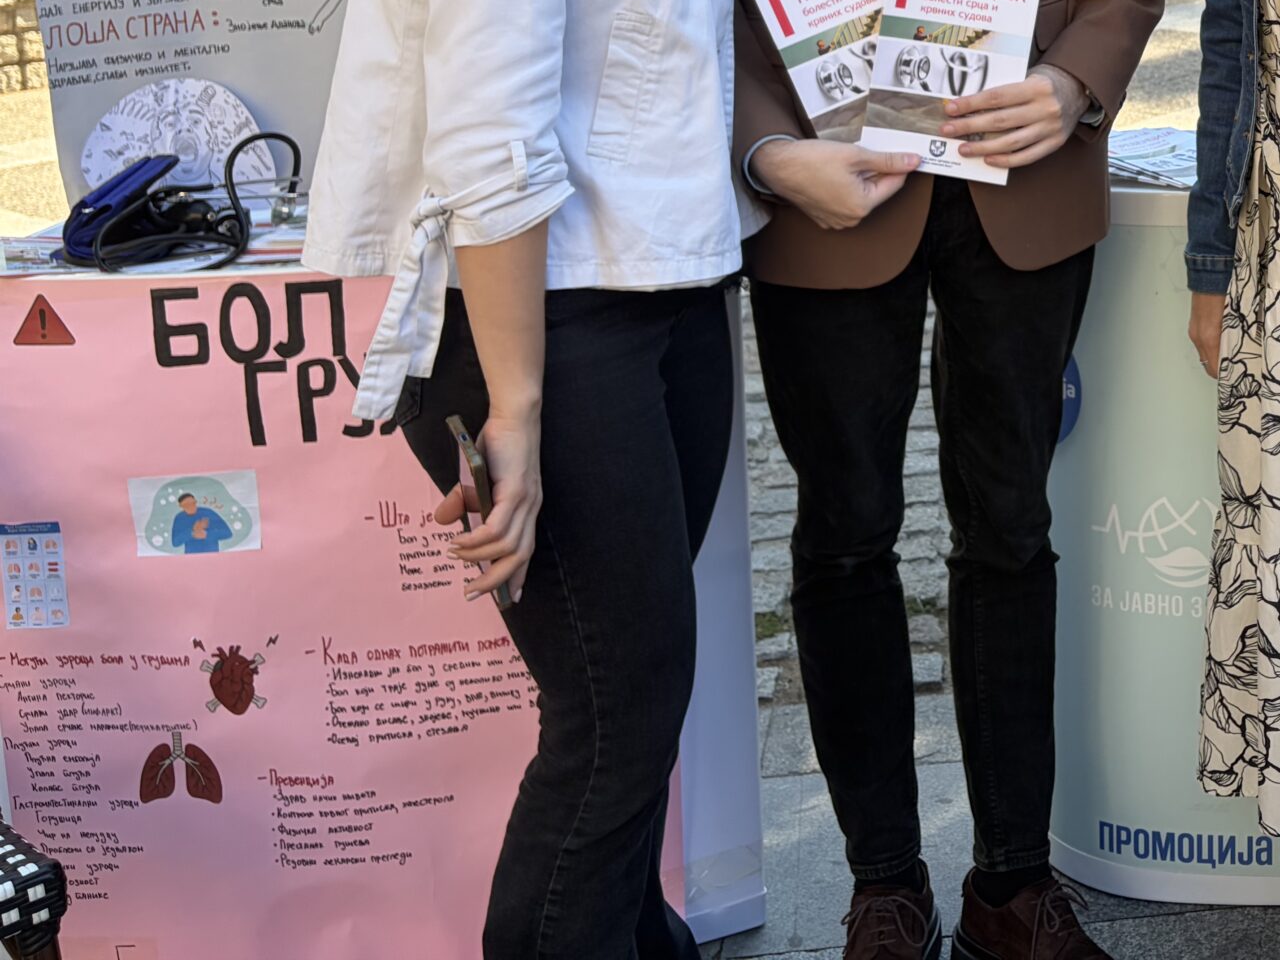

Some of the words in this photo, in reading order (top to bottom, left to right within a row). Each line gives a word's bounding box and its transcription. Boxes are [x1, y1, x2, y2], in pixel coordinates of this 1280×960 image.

[38, 3, 64, 19] ДАЈЕ
[920, 5, 956, 20] крвних
[958, 9, 993, 24] судова
[965, 0, 990, 14] срца
[807, 9, 844, 29] крвних
[46, 18, 120, 50] ЛОША
[104, 52, 153, 66] ФИЗИЧКО
[157, 50, 166, 60] И
[173, 43, 231, 58] МЕНТАЛНО
[150, 278, 346, 368] БОЛ
[379, 500, 411, 528] Шта
[1091, 584, 1114, 609] ЗА
[1119, 591, 1184, 617] ЈАВНО
[129, 654, 139, 671] у
